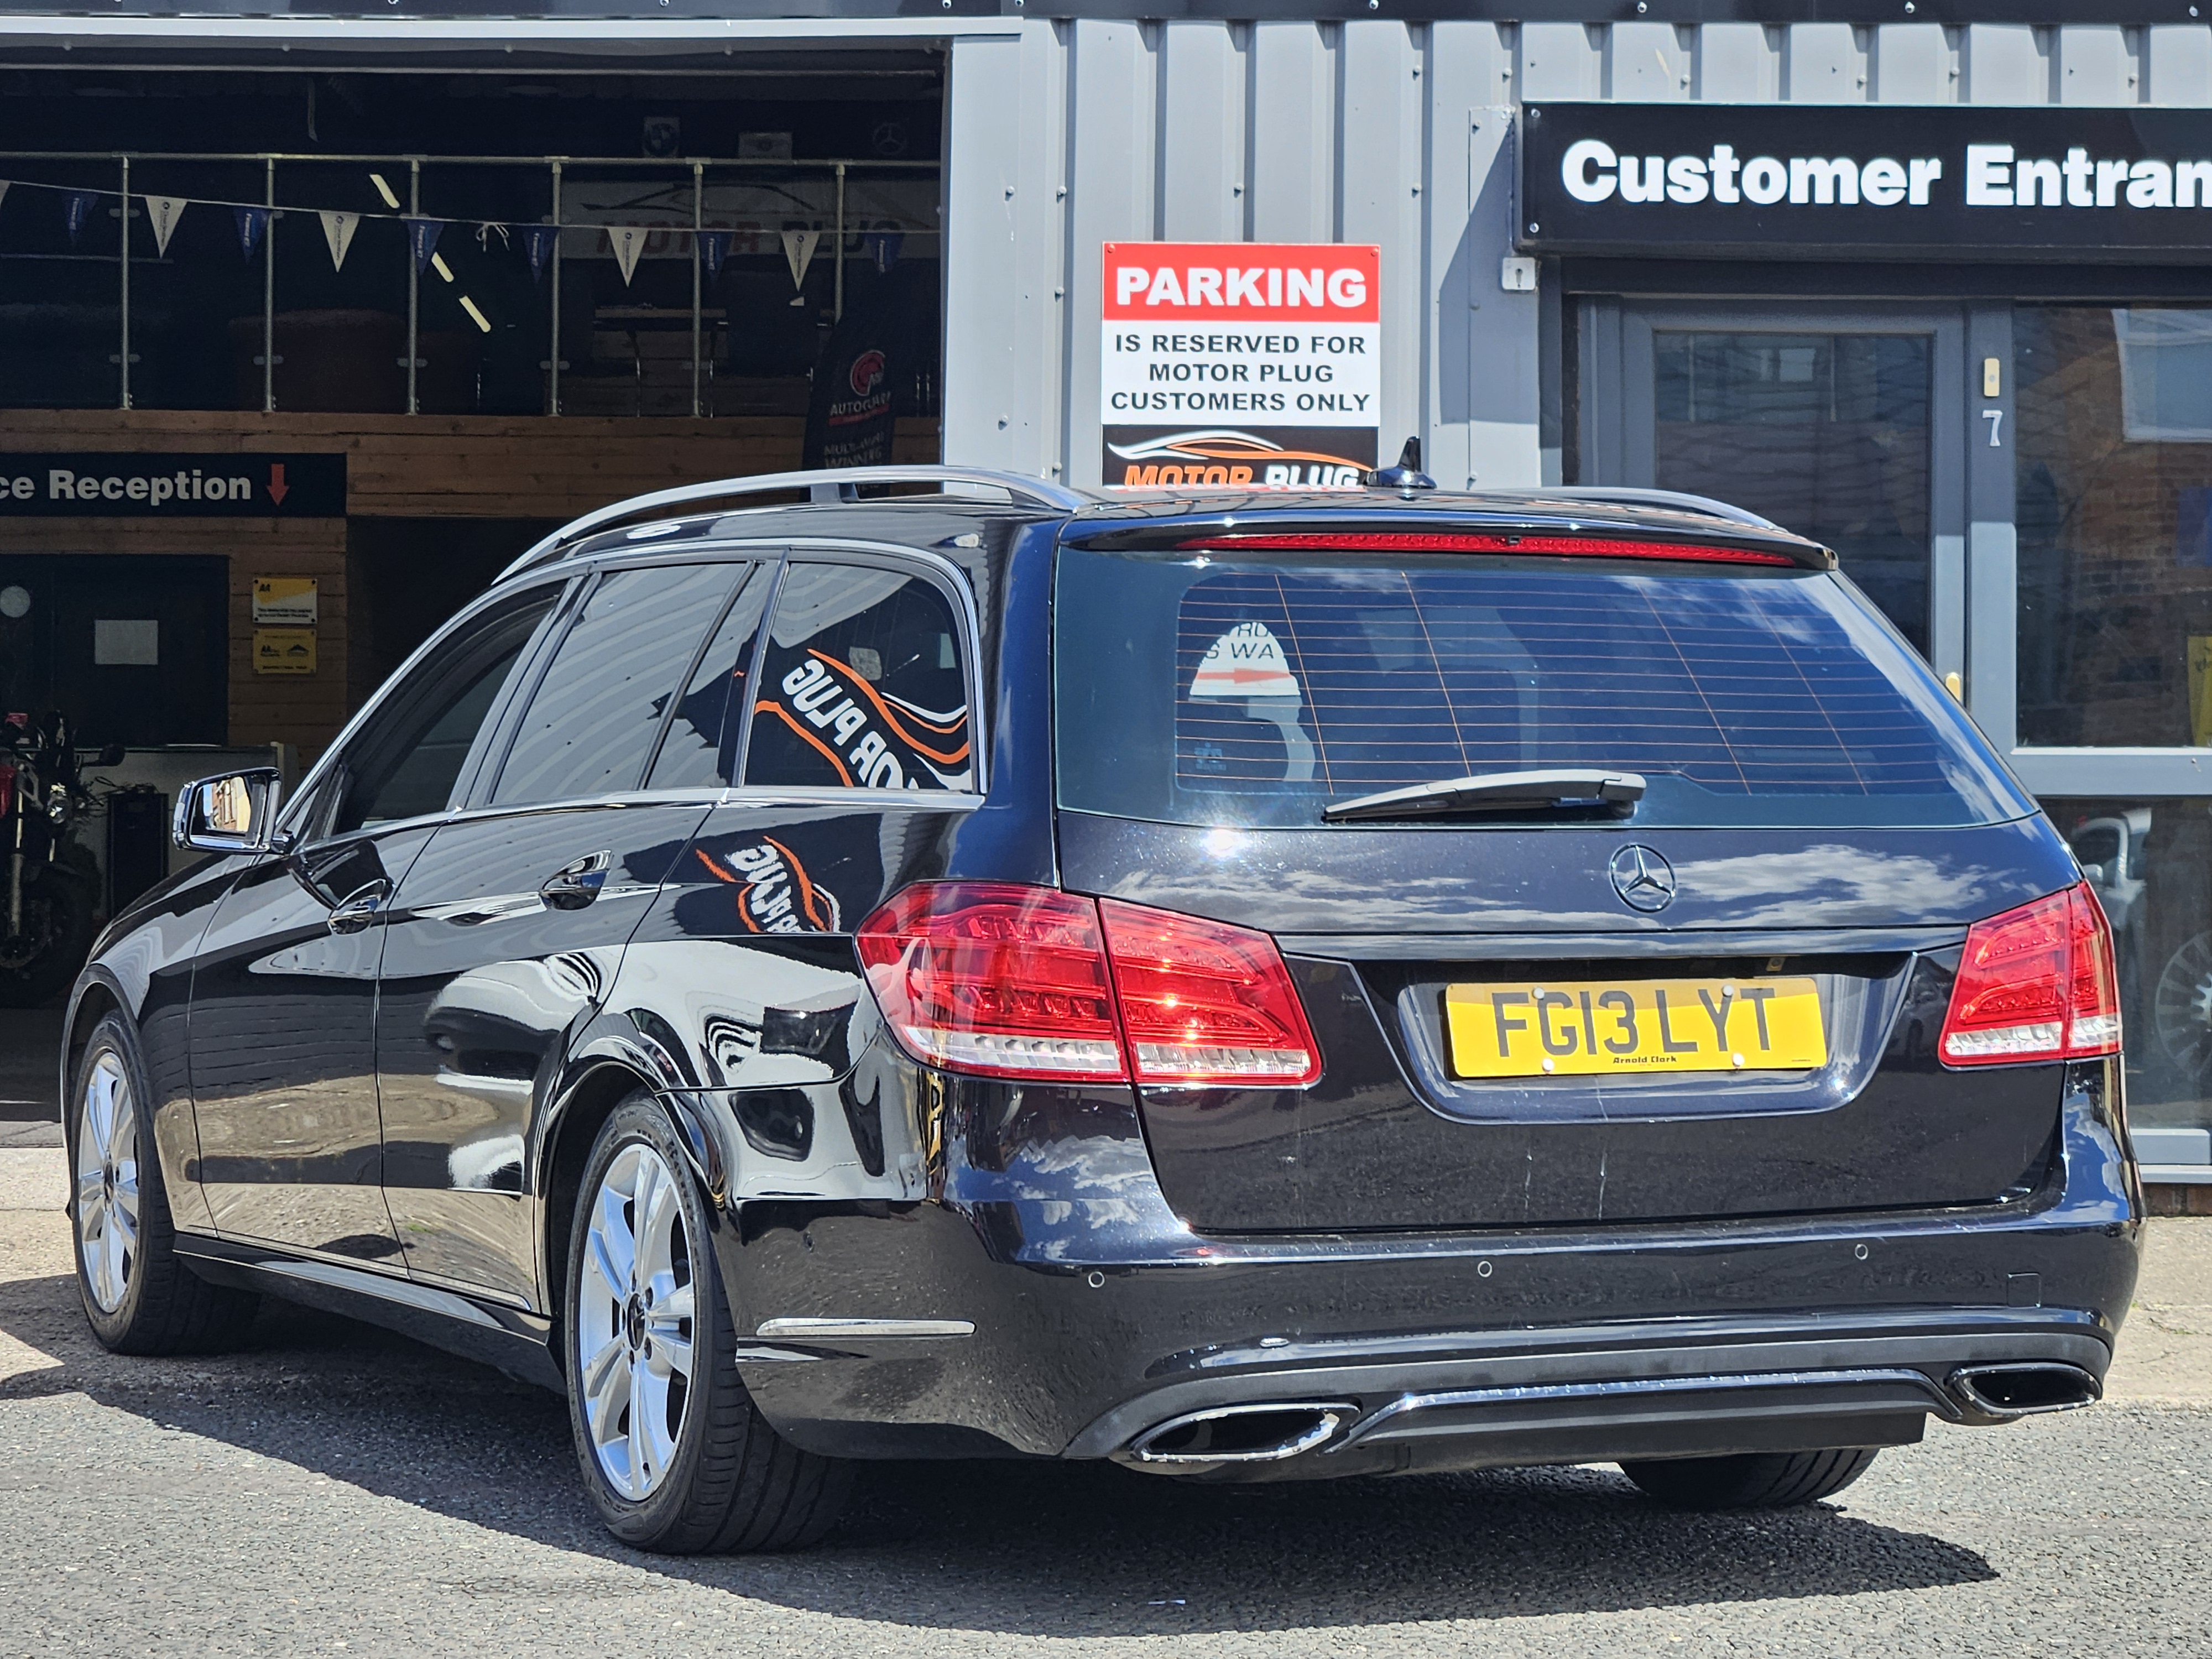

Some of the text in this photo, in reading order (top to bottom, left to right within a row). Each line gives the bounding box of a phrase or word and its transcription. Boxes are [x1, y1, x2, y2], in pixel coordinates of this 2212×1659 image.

[1562, 139, 2212, 207] Customer Entran
[1117, 267, 1366, 307] PARKING
[1116, 335, 1365, 354] IS RESERVED FOR
[1150, 364, 1333, 382] MOTOR PLUG
[1111, 392, 1370, 411] CUSTOMERS ONLY
[1983, 410, 2002, 446] 7
[49, 469, 251, 506] Reception
[1124, 465, 1359, 486] MOTOR PLUG
[1492, 988, 1776, 1057] FG13 LYT
